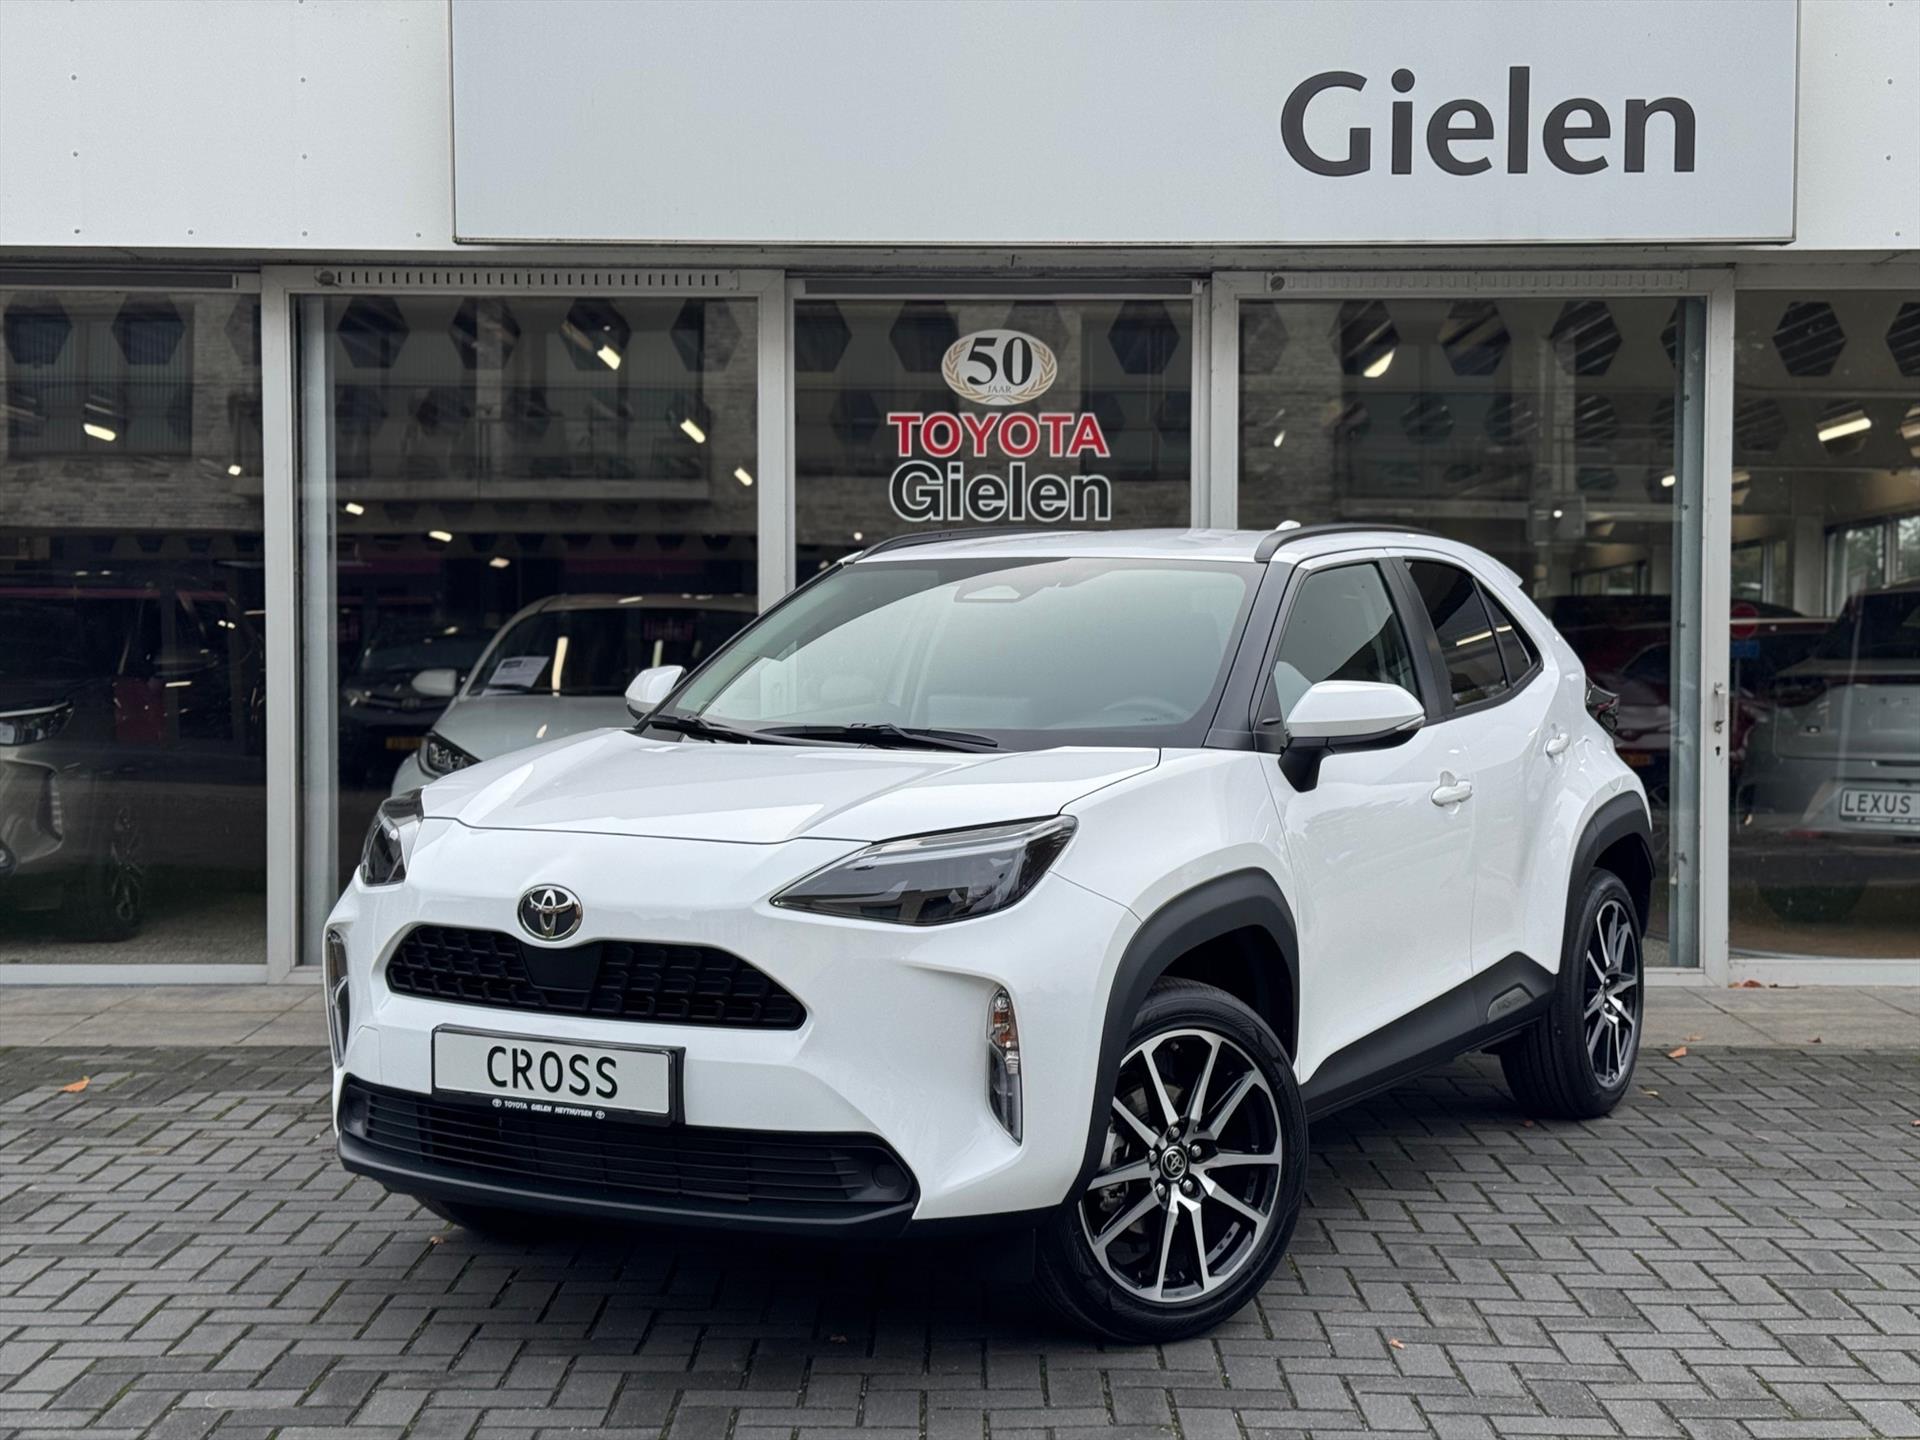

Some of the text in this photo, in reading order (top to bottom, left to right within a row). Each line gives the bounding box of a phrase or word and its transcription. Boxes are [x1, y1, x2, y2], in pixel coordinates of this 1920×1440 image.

[1281, 66, 1696, 177] Gielen
[966, 337, 1033, 386] 50
[986, 384, 1012, 393] JAAR
[887, 412, 1110, 457] TOYOTA
[889, 460, 1111, 522] Gielen
[1843, 793, 1912, 814] LEXUS
[487, 1045, 618, 1099] CROSS
[504, 1100, 527, 1109] TOYOTA
[531, 1104, 552, 1112] GIELEN
